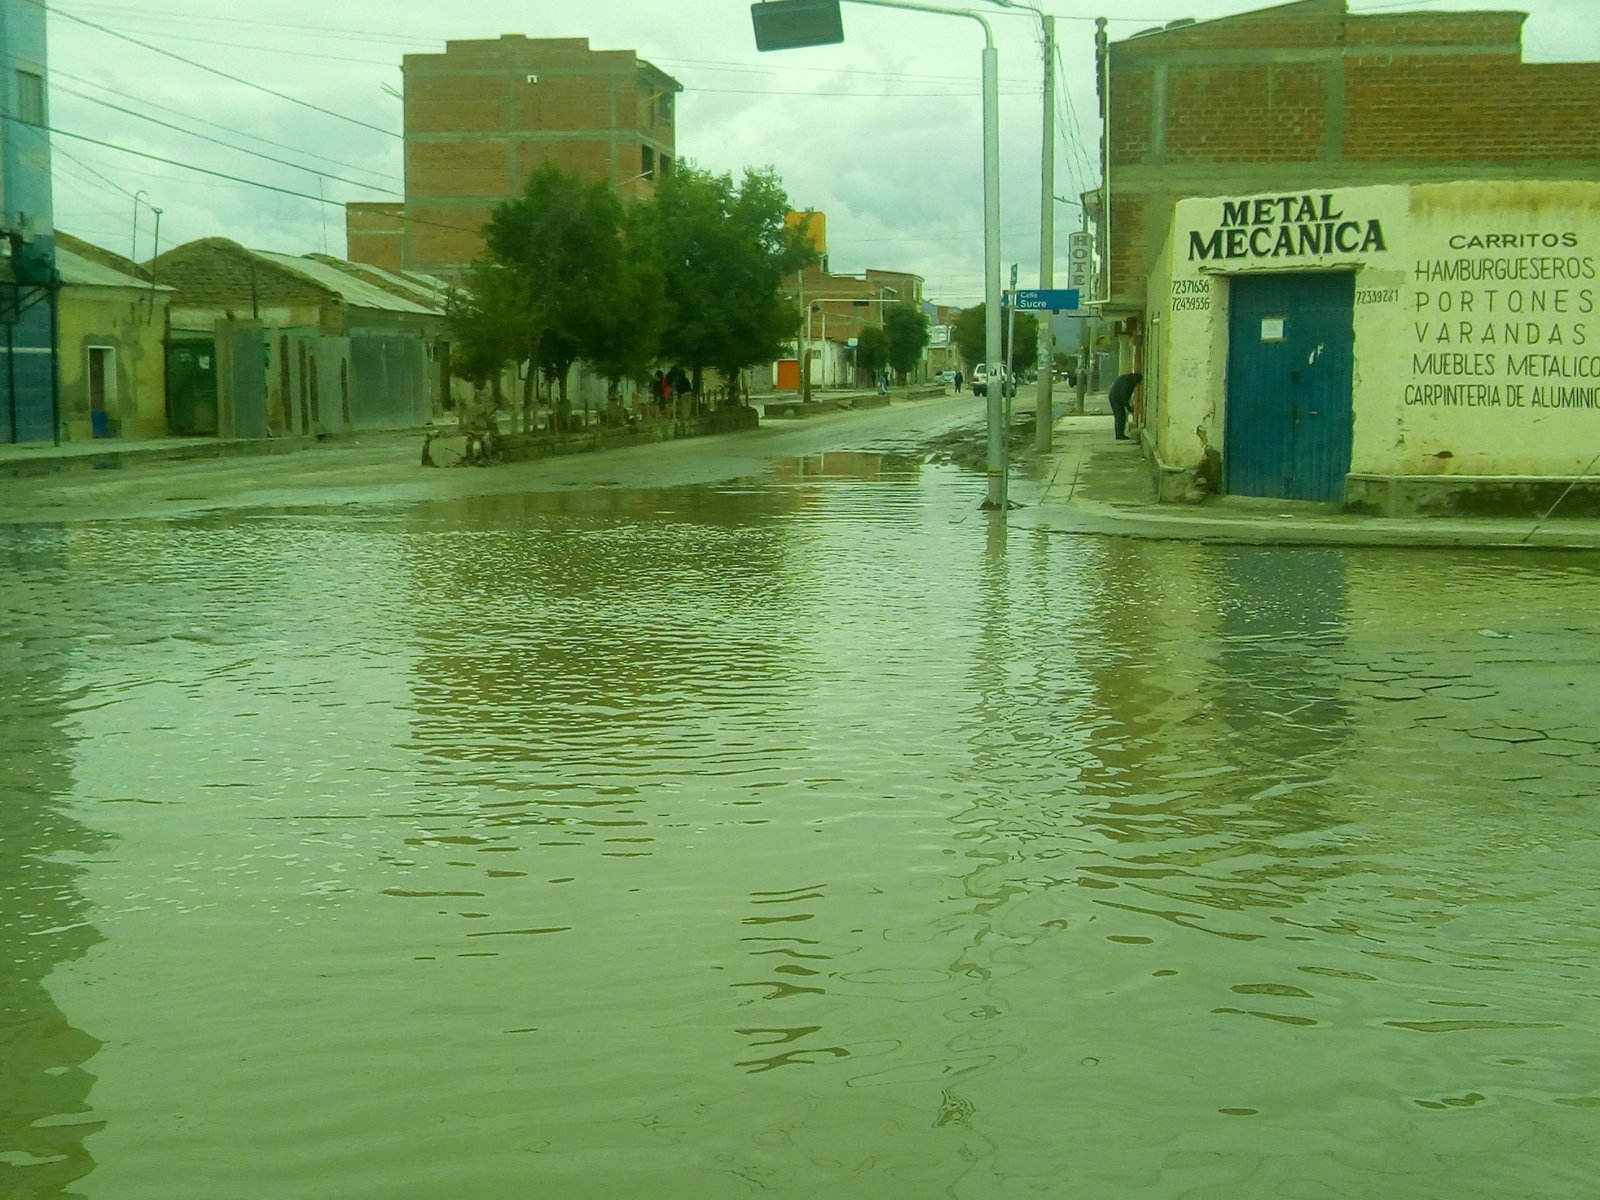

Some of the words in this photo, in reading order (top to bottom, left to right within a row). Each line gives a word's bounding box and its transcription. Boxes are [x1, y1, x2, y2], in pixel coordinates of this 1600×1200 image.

[1220, 194, 1343, 227] METAL
[1188, 219, 1388, 261] MECANICA
[1449, 232, 1578, 250] CARRITOS
[1072, 235, 1088, 298] HOTE
[1414, 257, 1595, 282] HAMBURGUESEROS
[1172, 279, 1210, 294] 72371656
[1020, 299, 1047, 308] Sucre
[1415, 289, 1594, 313] PORTONES
[1415, 321, 1586, 345] VARANDAS
[1413, 353, 1495, 375] MUEBLES
[1507, 354, 1600, 377] METALICO
[1405, 384, 1501, 407] CARPINTERIA
[1506, 385, 1525, 407] DE
